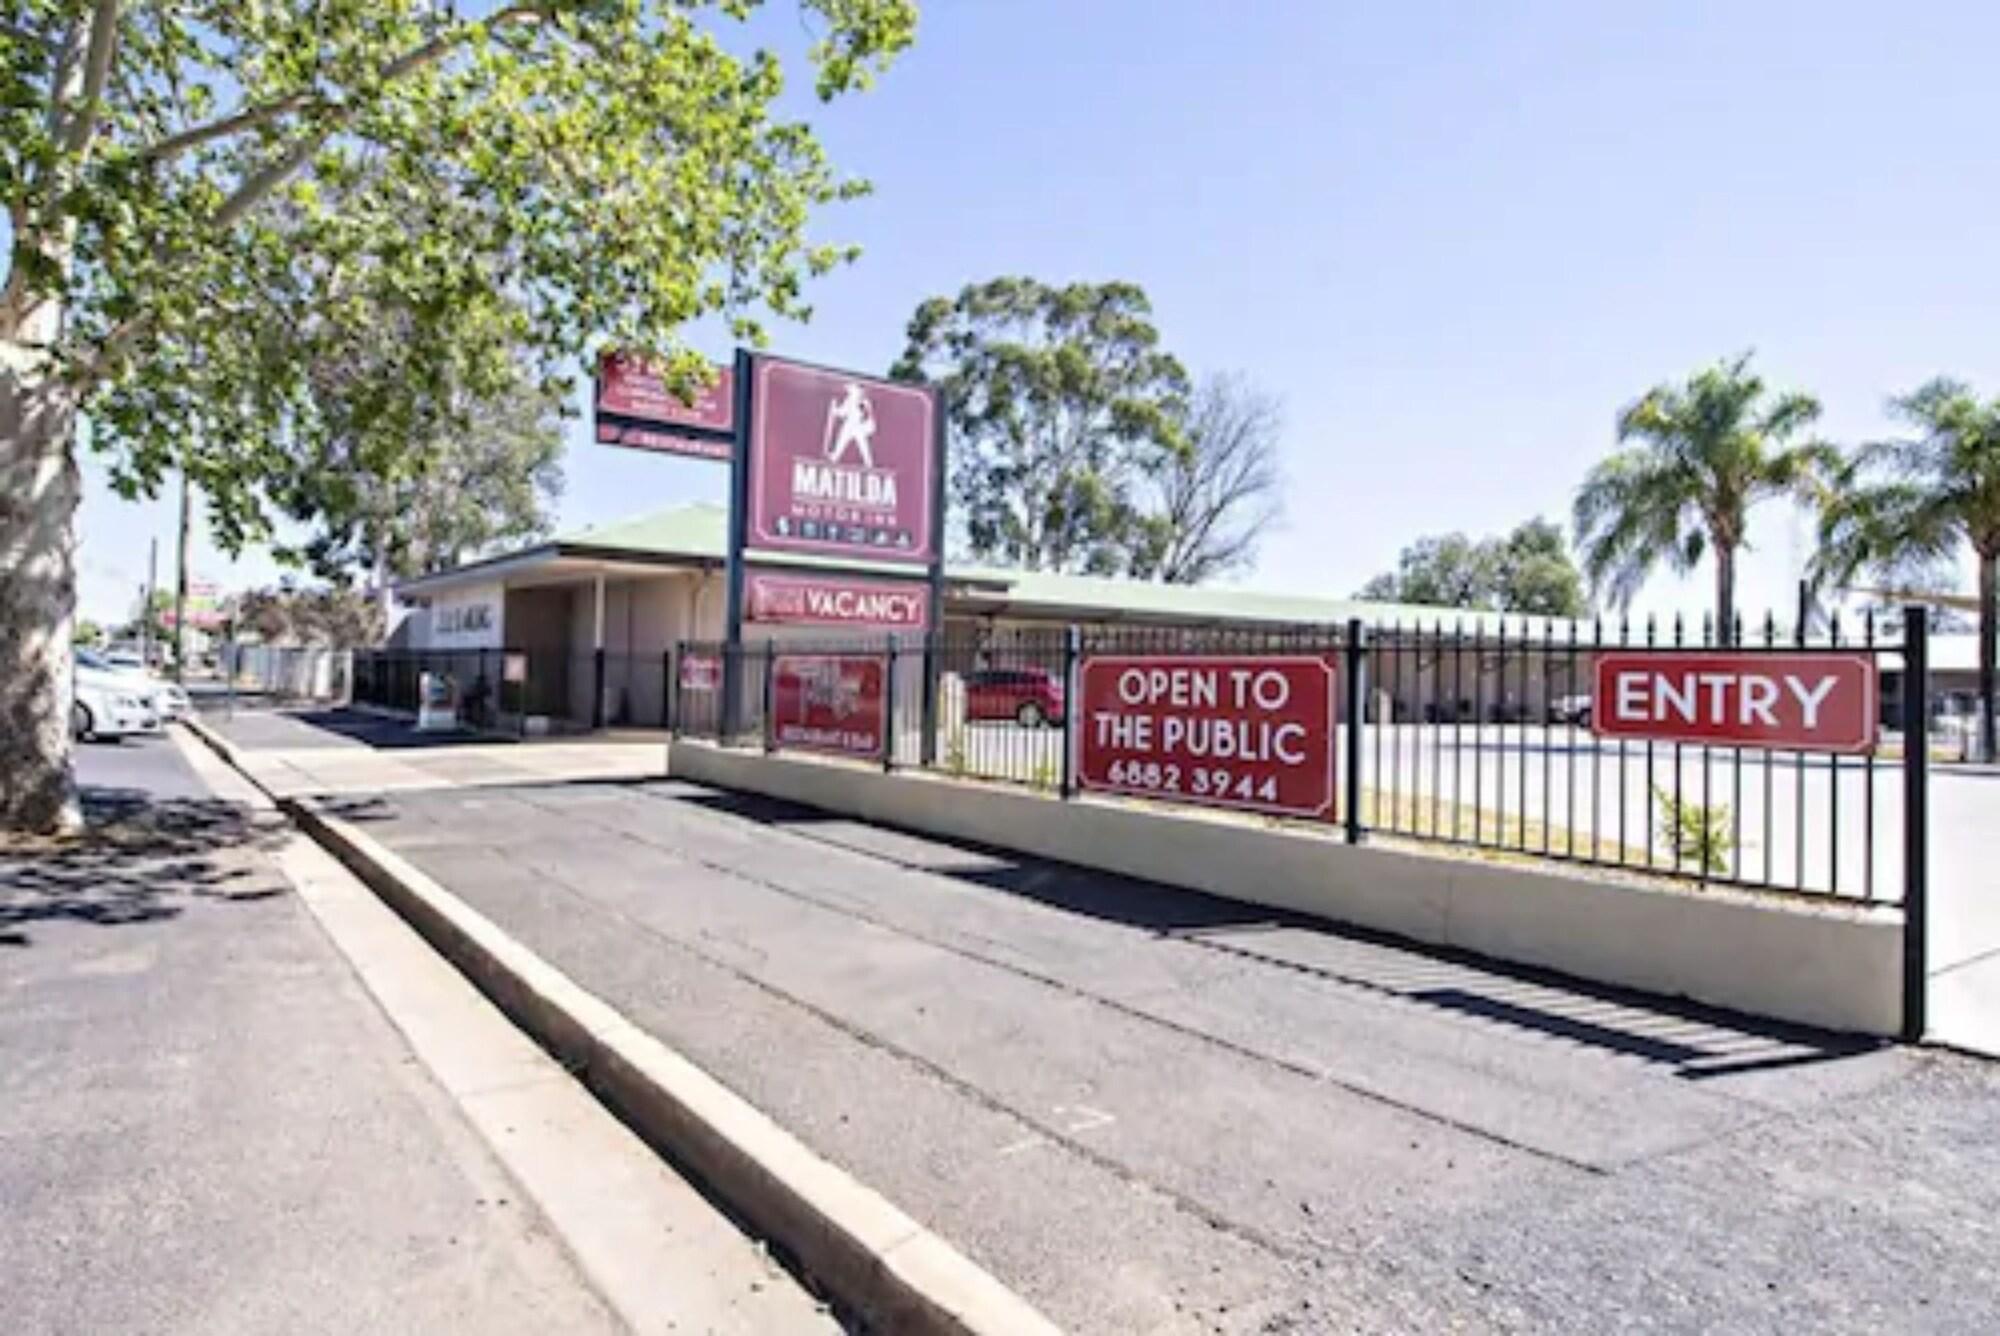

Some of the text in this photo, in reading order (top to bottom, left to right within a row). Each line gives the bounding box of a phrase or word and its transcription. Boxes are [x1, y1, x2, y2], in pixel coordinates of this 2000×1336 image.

[792, 462, 897, 506] MATILDA
[806, 586, 919, 622] VACANCY
[1118, 668, 1290, 710] OPEN TO
[1615, 671, 1840, 729] ENTRY
[1093, 712, 1306, 765] THE PUBLIC
[1107, 759, 1277, 801] 6882 3944
